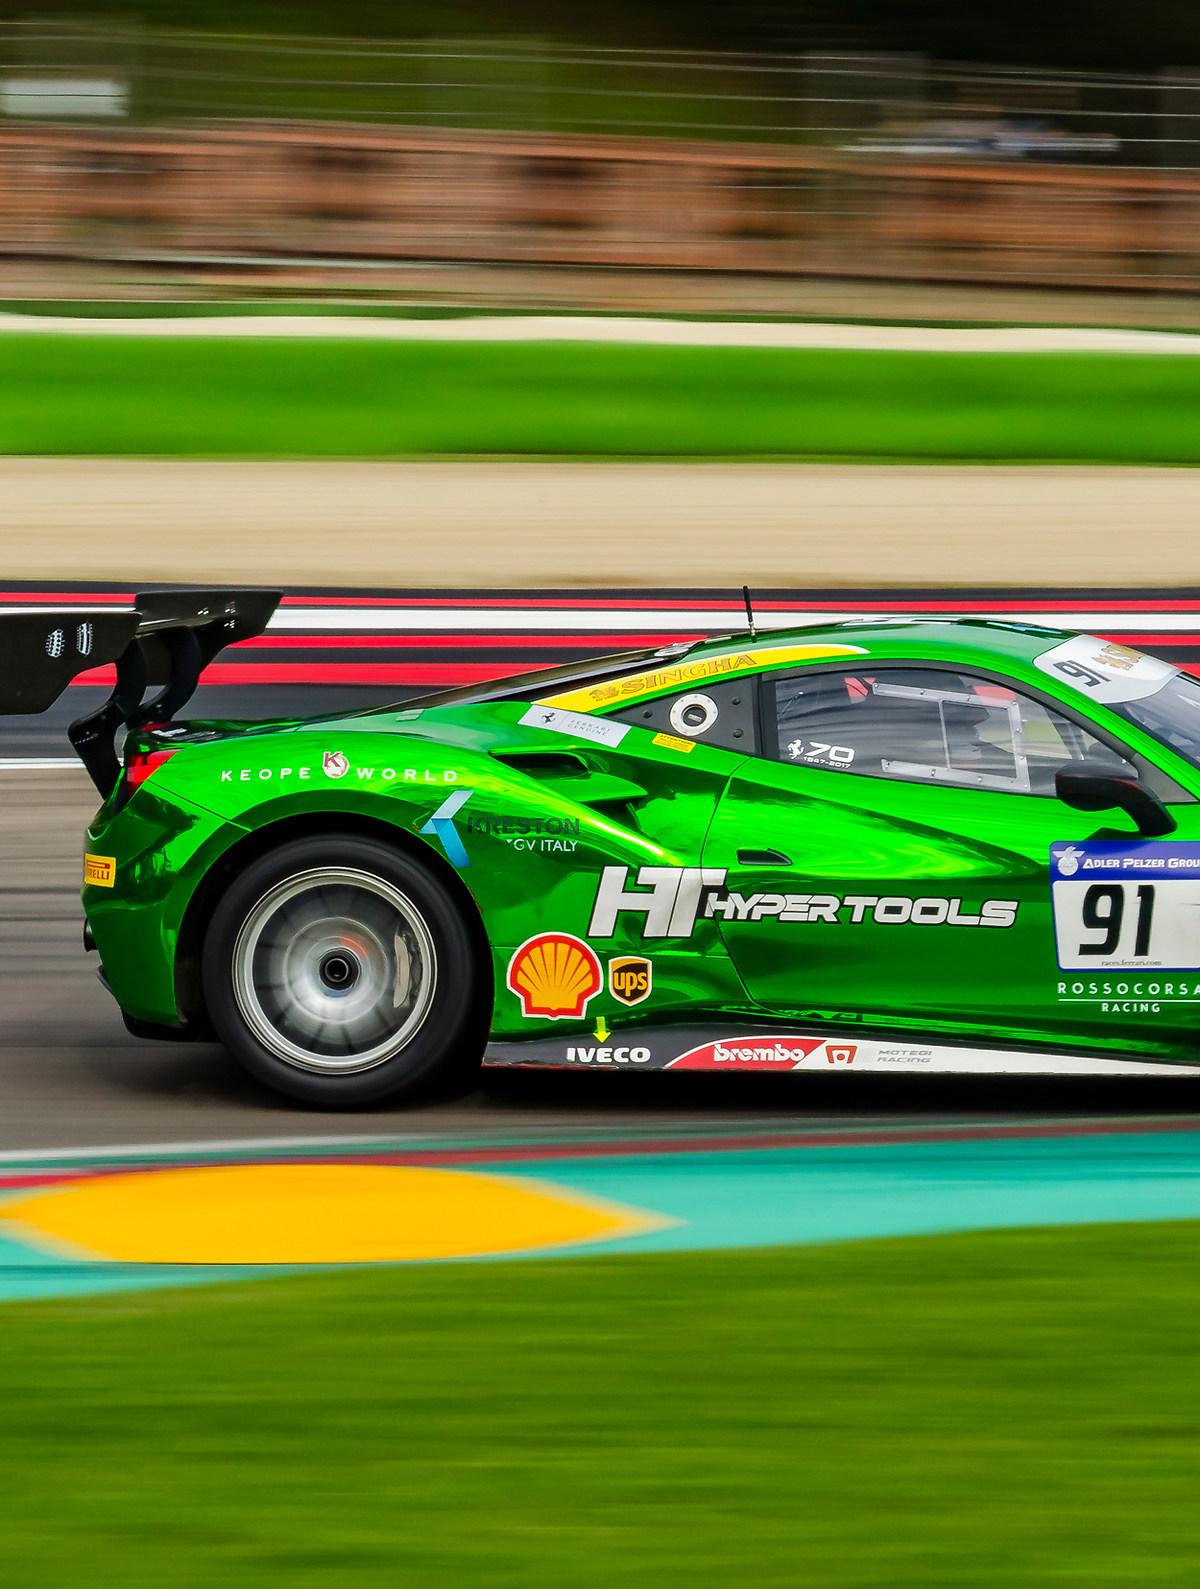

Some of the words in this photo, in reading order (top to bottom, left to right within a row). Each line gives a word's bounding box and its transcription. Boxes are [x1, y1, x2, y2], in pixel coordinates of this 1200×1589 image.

[620, 654, 758, 695] SINGHA
[804, 741, 855, 763] 70
[803, 756, 851, 769] 1947-2017
[221, 767, 311, 782] KEOPE
[356, 767, 457, 782] WORLD
[467, 816, 580, 836] KRESTON
[513, 838, 536, 851] GV
[540, 839, 579, 852] ITALY
[1082, 858, 1120, 869] ADLER
[1122, 857, 1165, 869] PELZER
[586, 865, 729, 938] HT
[1078, 884, 1156, 957] 91
[613, 971, 648, 997] ups
[1101, 1003, 1160, 1013] RACING
[566, 1046, 651, 1064] IVECO
[713, 1043, 805, 1063] brembo
